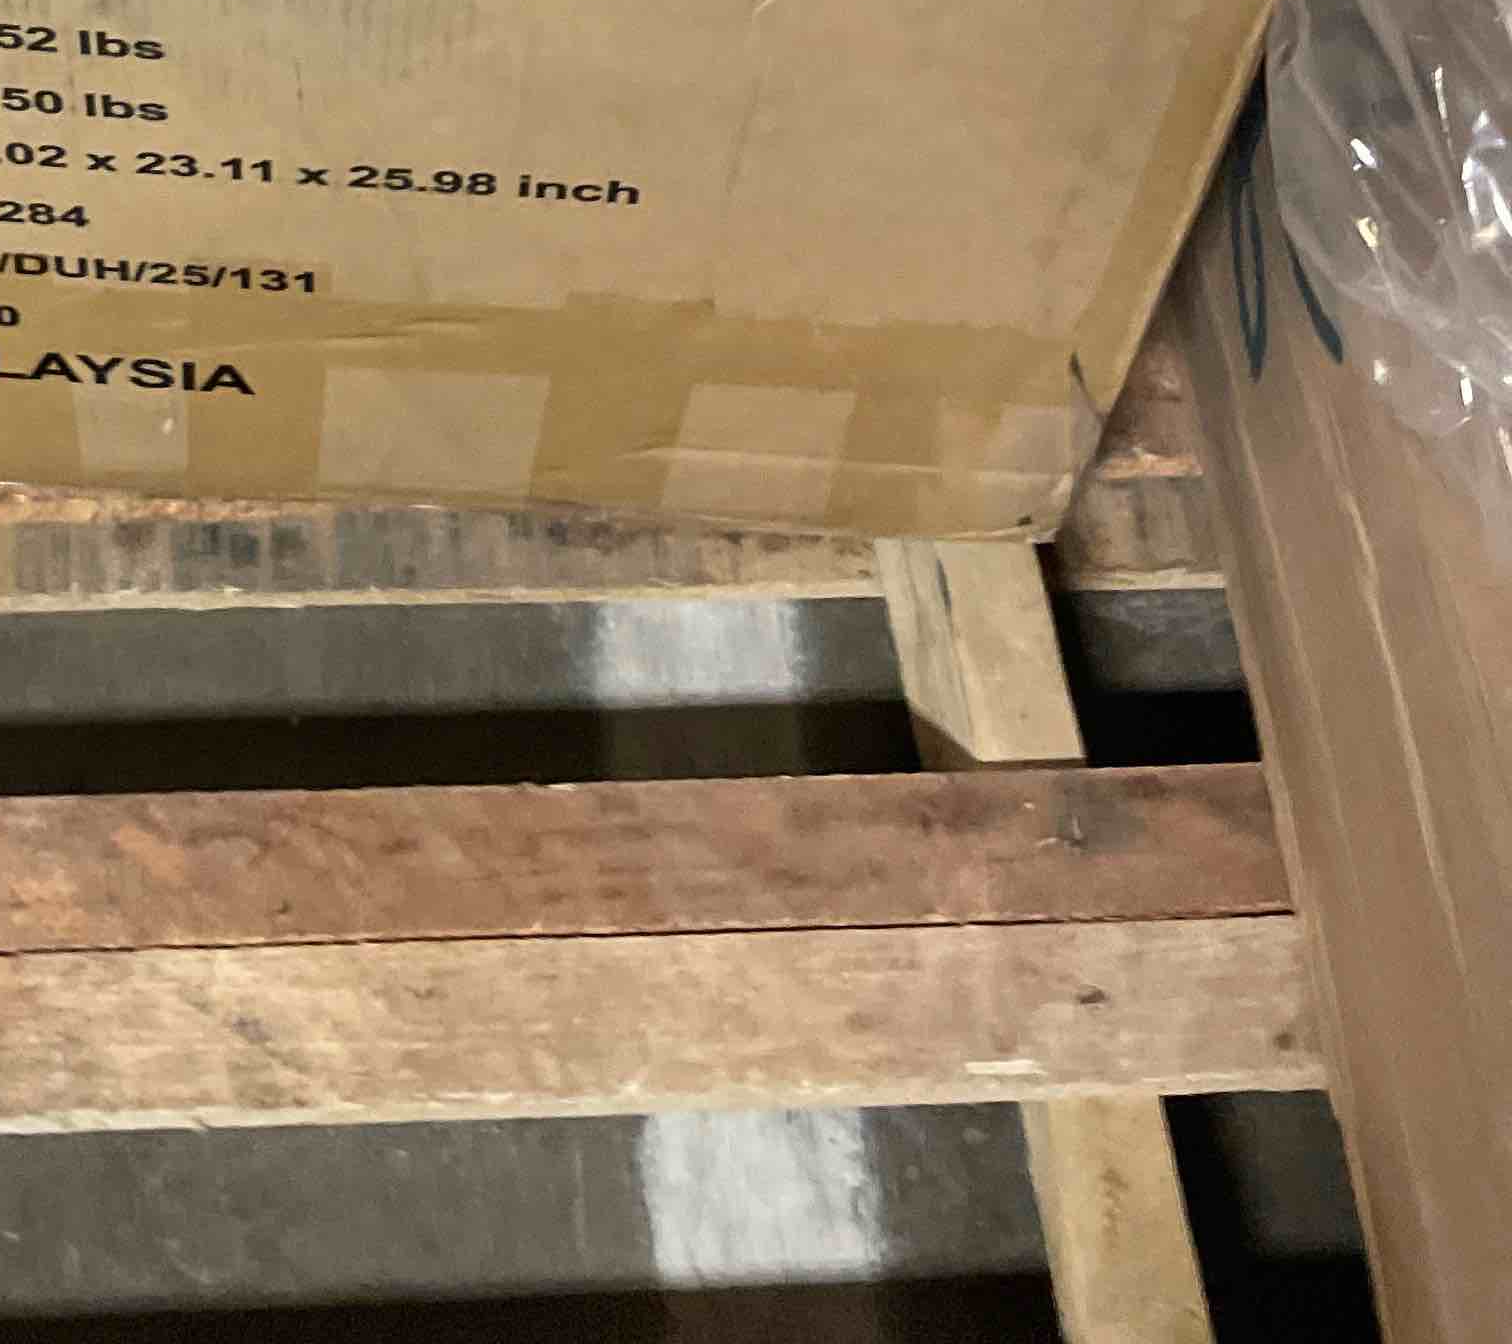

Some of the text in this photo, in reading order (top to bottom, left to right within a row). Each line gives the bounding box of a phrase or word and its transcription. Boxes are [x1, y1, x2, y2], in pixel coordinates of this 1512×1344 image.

[78, 29, 165, 60] lbs
[84, 93, 169, 122] lbs
[85, 153, 117, 173] x
[135, 151, 272, 183] 23.11
[297, 167, 329, 186] x
[347, 165, 497, 197] 25.98
[518, 174, 640, 205] inch
